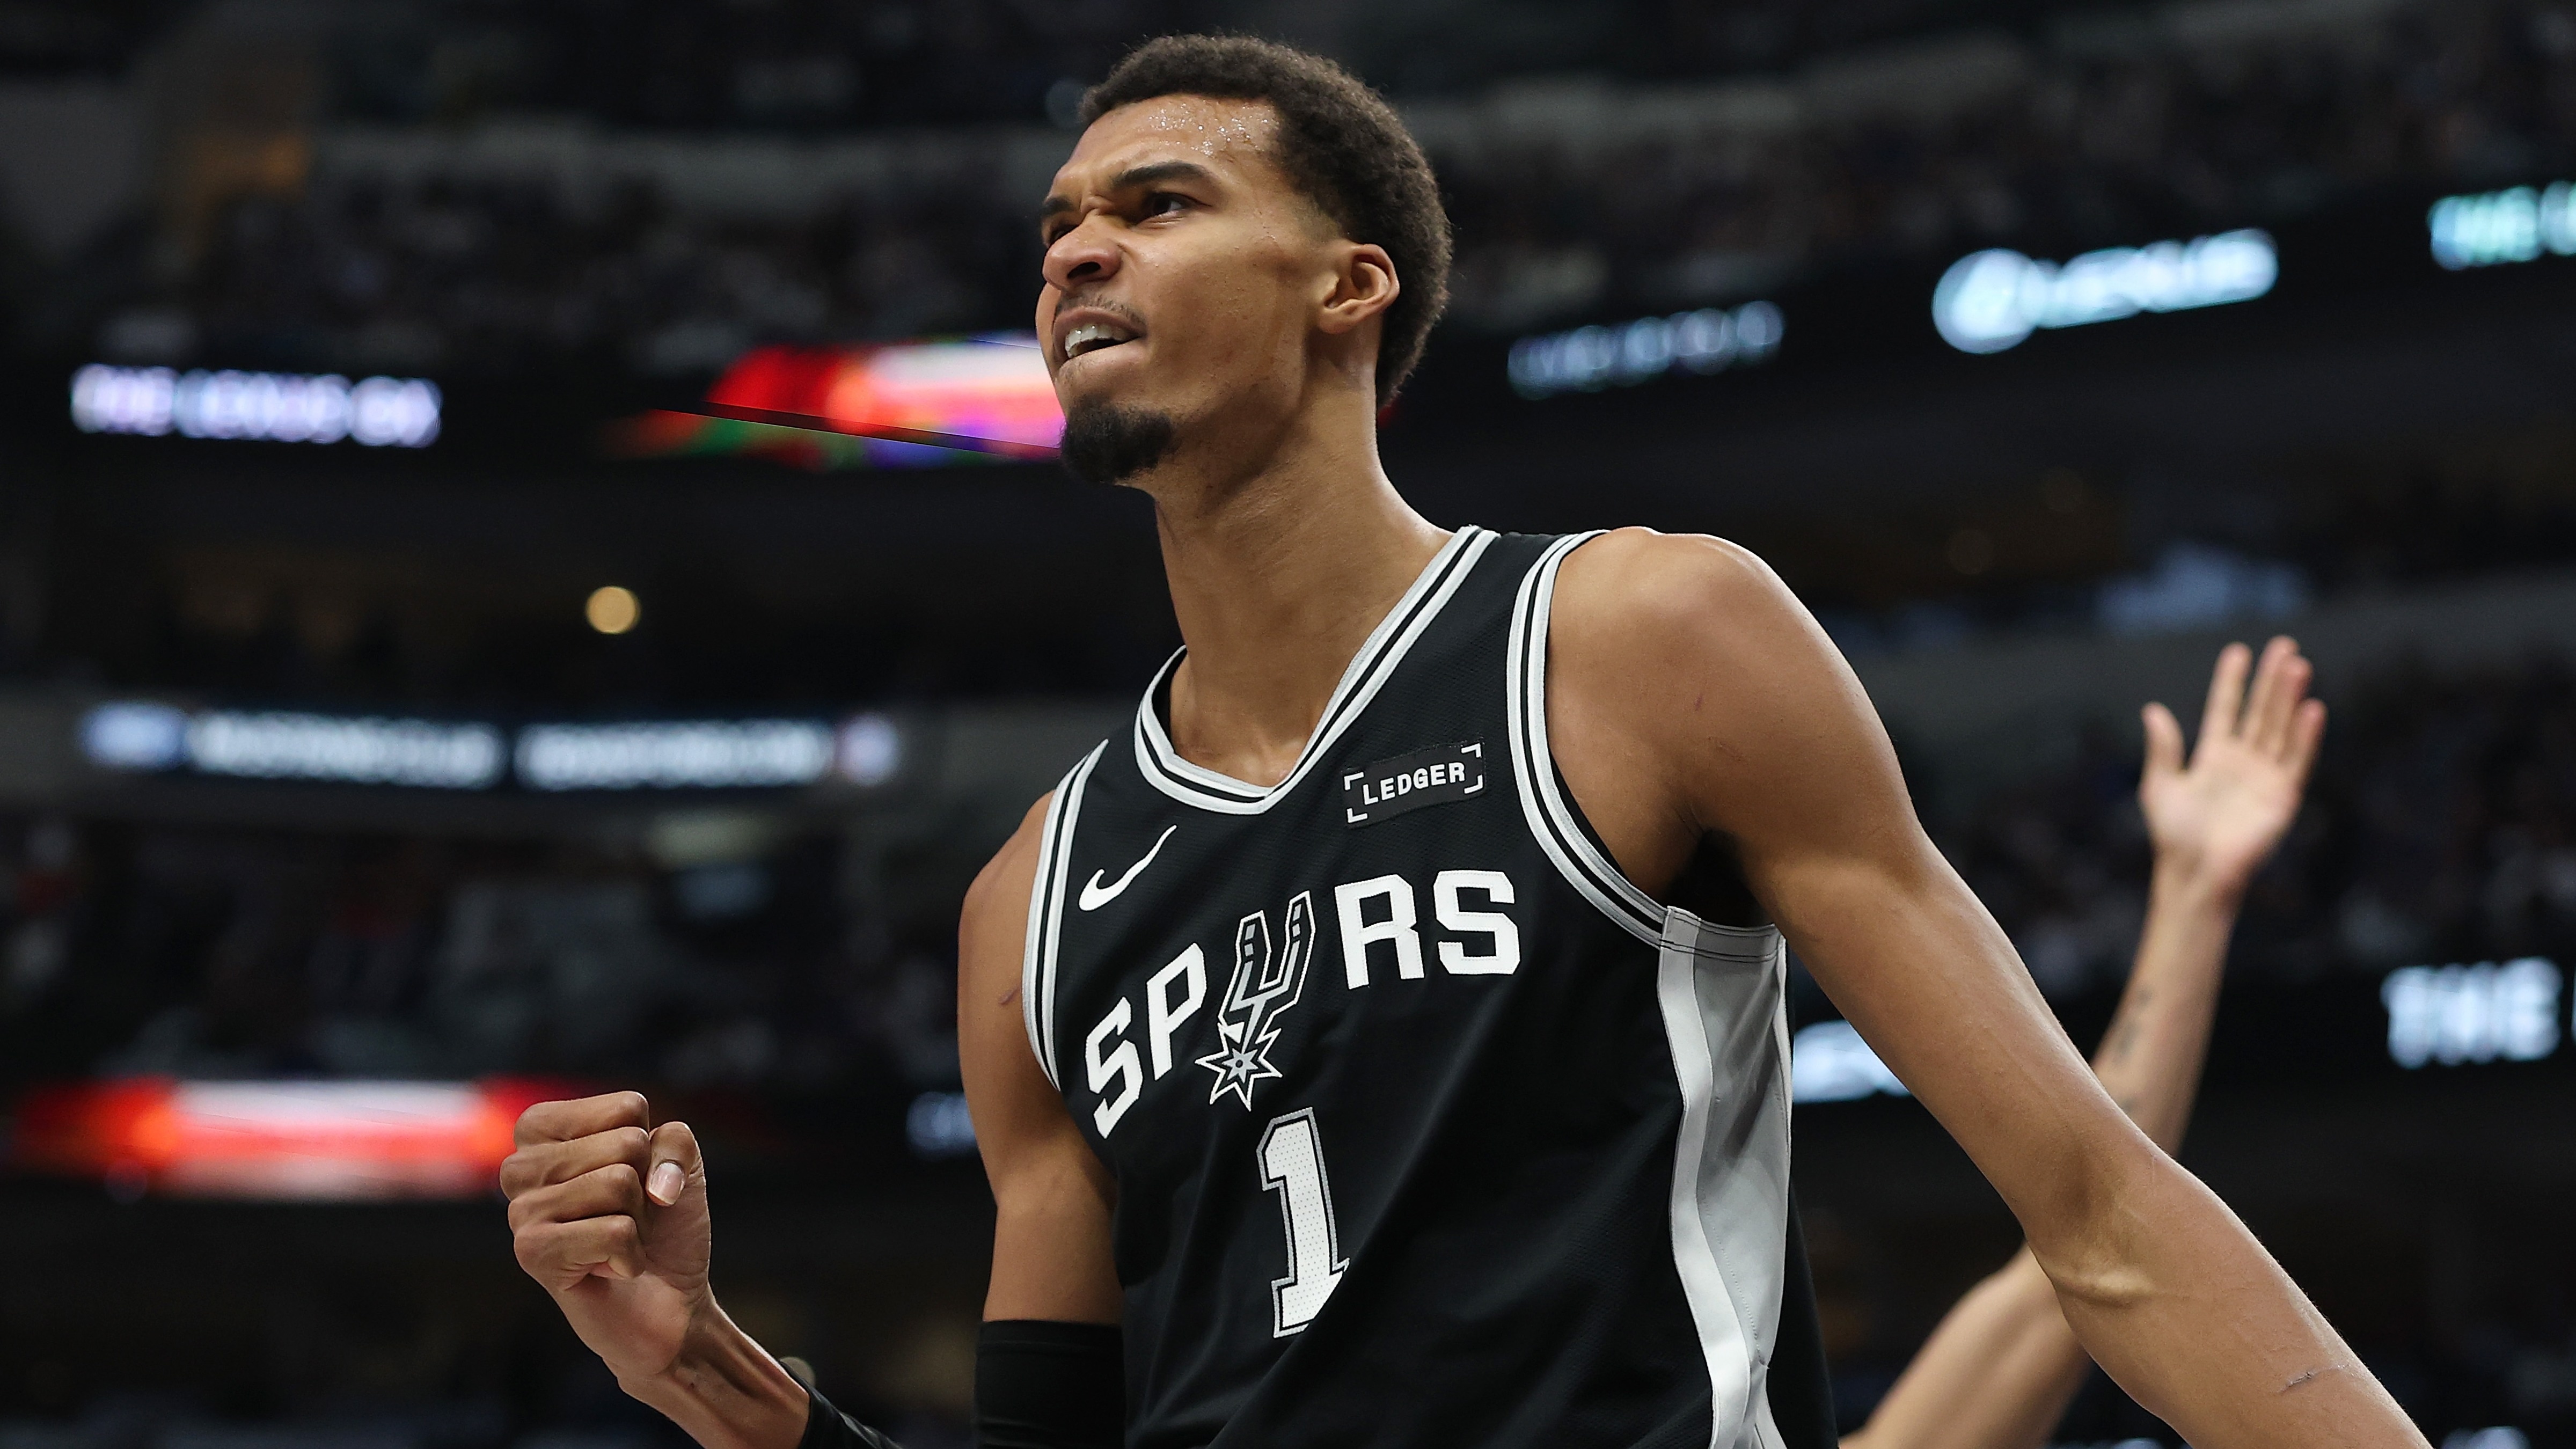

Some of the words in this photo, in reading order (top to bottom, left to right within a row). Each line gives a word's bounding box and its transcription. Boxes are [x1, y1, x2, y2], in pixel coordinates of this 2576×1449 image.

[1363, 762, 1465, 805] LEDGER
[1085, 869, 1520, 1139] SPURS
[1256, 1107, 1349, 1338] 1
